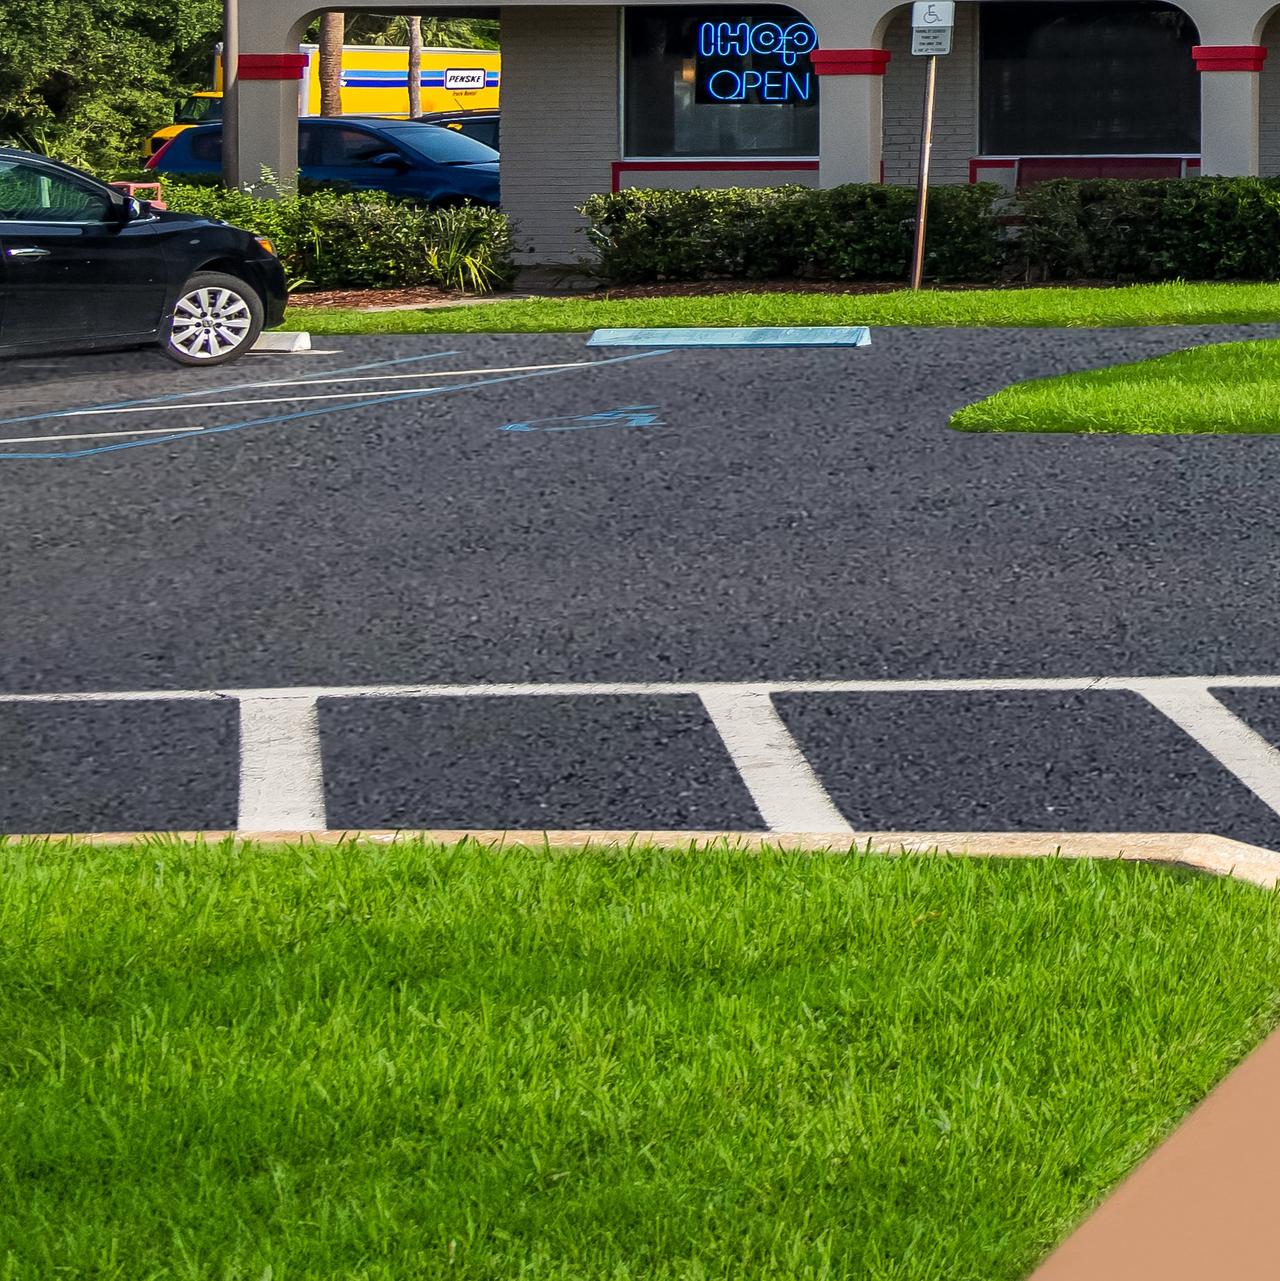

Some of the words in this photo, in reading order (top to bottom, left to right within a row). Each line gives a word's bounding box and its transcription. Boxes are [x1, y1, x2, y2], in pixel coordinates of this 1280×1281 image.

[701, 22, 818, 66] IHOP
[448, 75, 482, 83] PENSKE
[709, 70, 810, 100] OPEN
